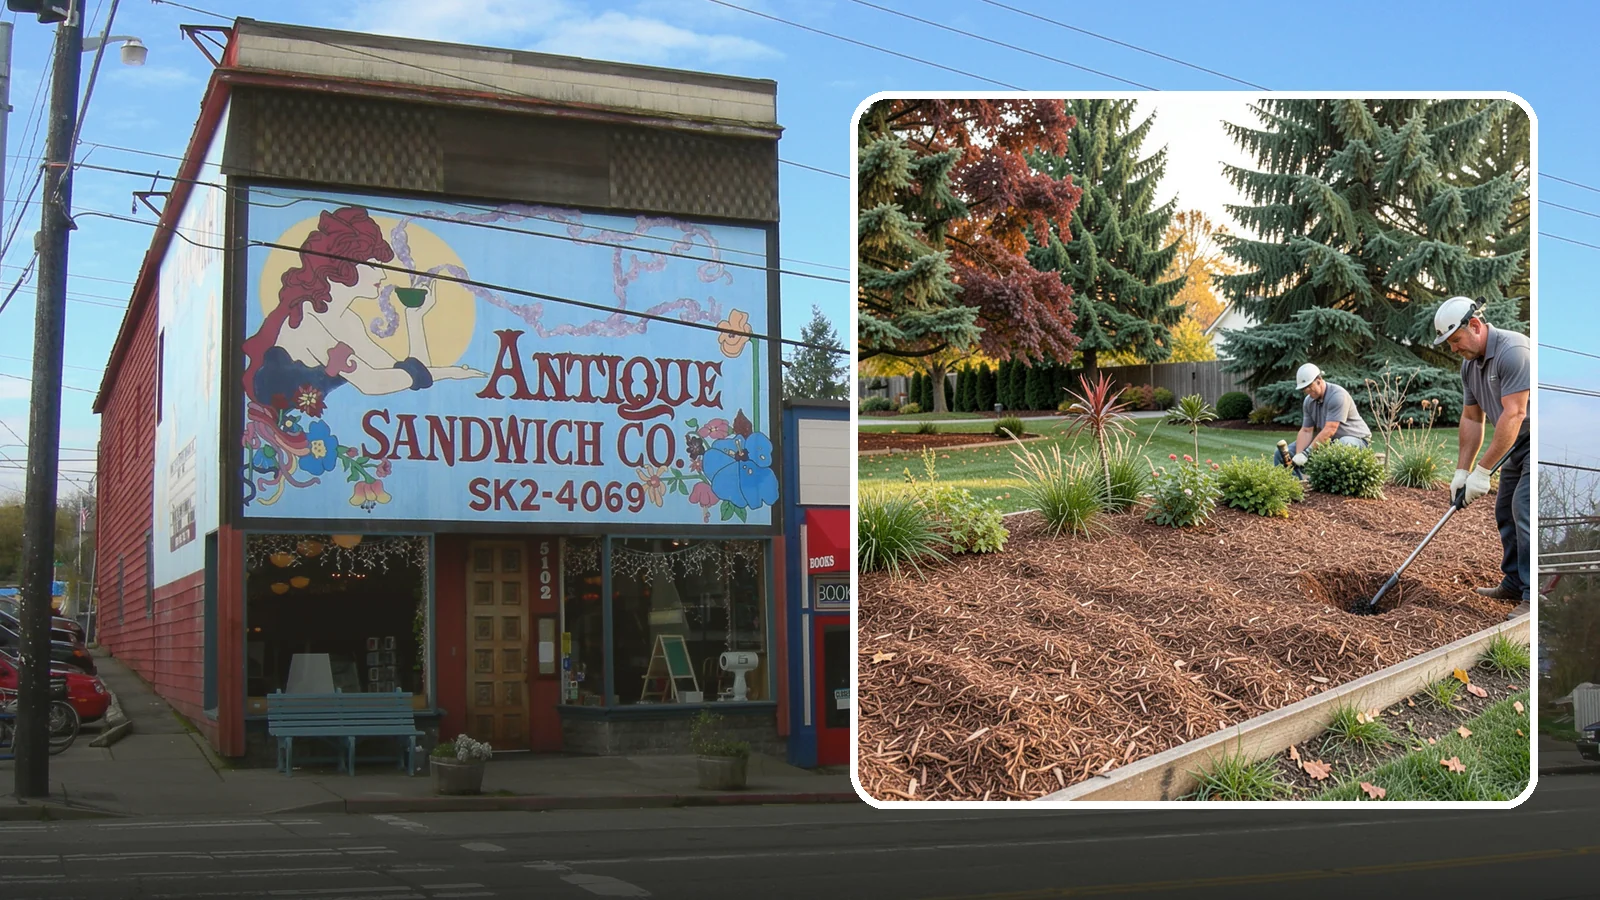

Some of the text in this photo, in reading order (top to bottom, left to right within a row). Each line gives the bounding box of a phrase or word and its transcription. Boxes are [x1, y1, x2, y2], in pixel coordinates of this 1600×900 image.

[476, 329, 724, 420] ANTIQUE
[361, 408, 685, 469] SANDWICH CO.
[468, 478, 646, 513] SK2-4069
[539, 541, 552, 600] 5102
[809, 555, 835, 569] BOOKS
